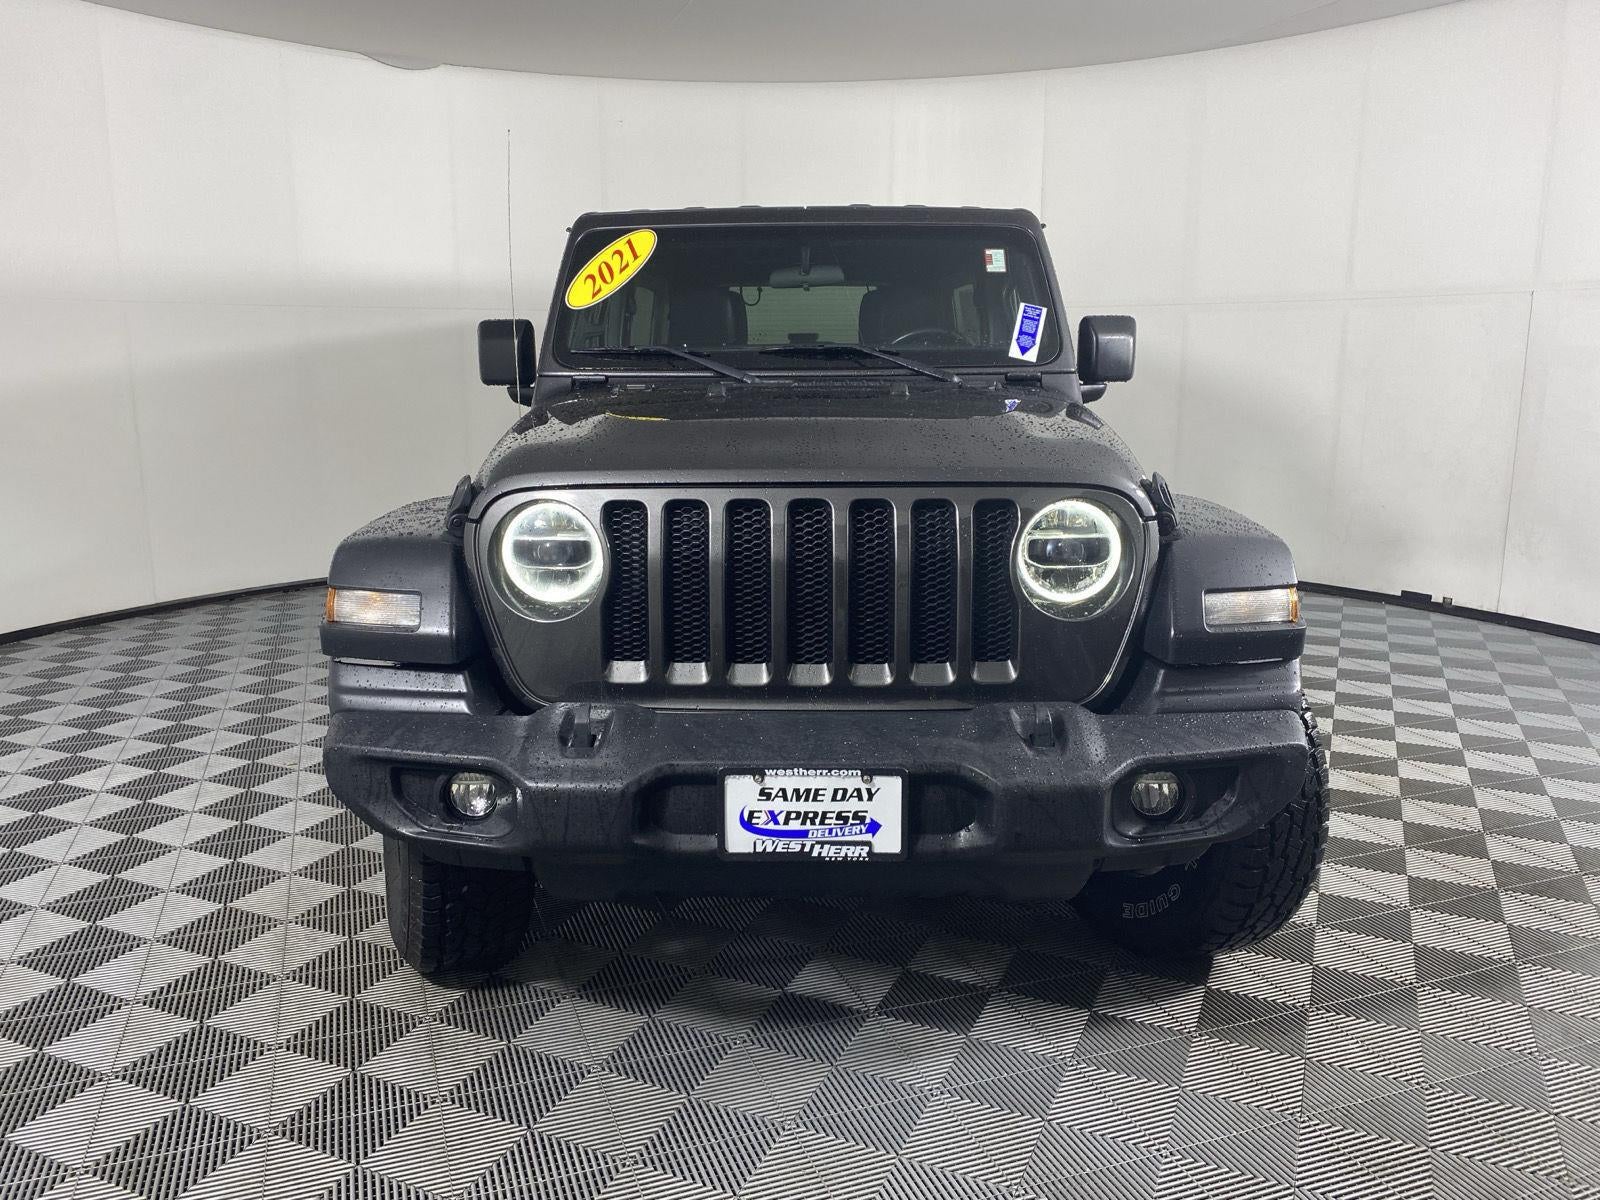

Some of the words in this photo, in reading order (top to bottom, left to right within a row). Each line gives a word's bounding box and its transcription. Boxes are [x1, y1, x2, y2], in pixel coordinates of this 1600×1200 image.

[584, 238, 641, 300] 2021
[764, 768, 862, 776] westherr.com
[757, 787, 827, 802] SAME
[830, 787, 881, 802] DAY
[747, 810, 868, 826] EXPRESS
[808, 824, 869, 839] DELIVERY
[1121, 883, 1181, 919] GUIDE
